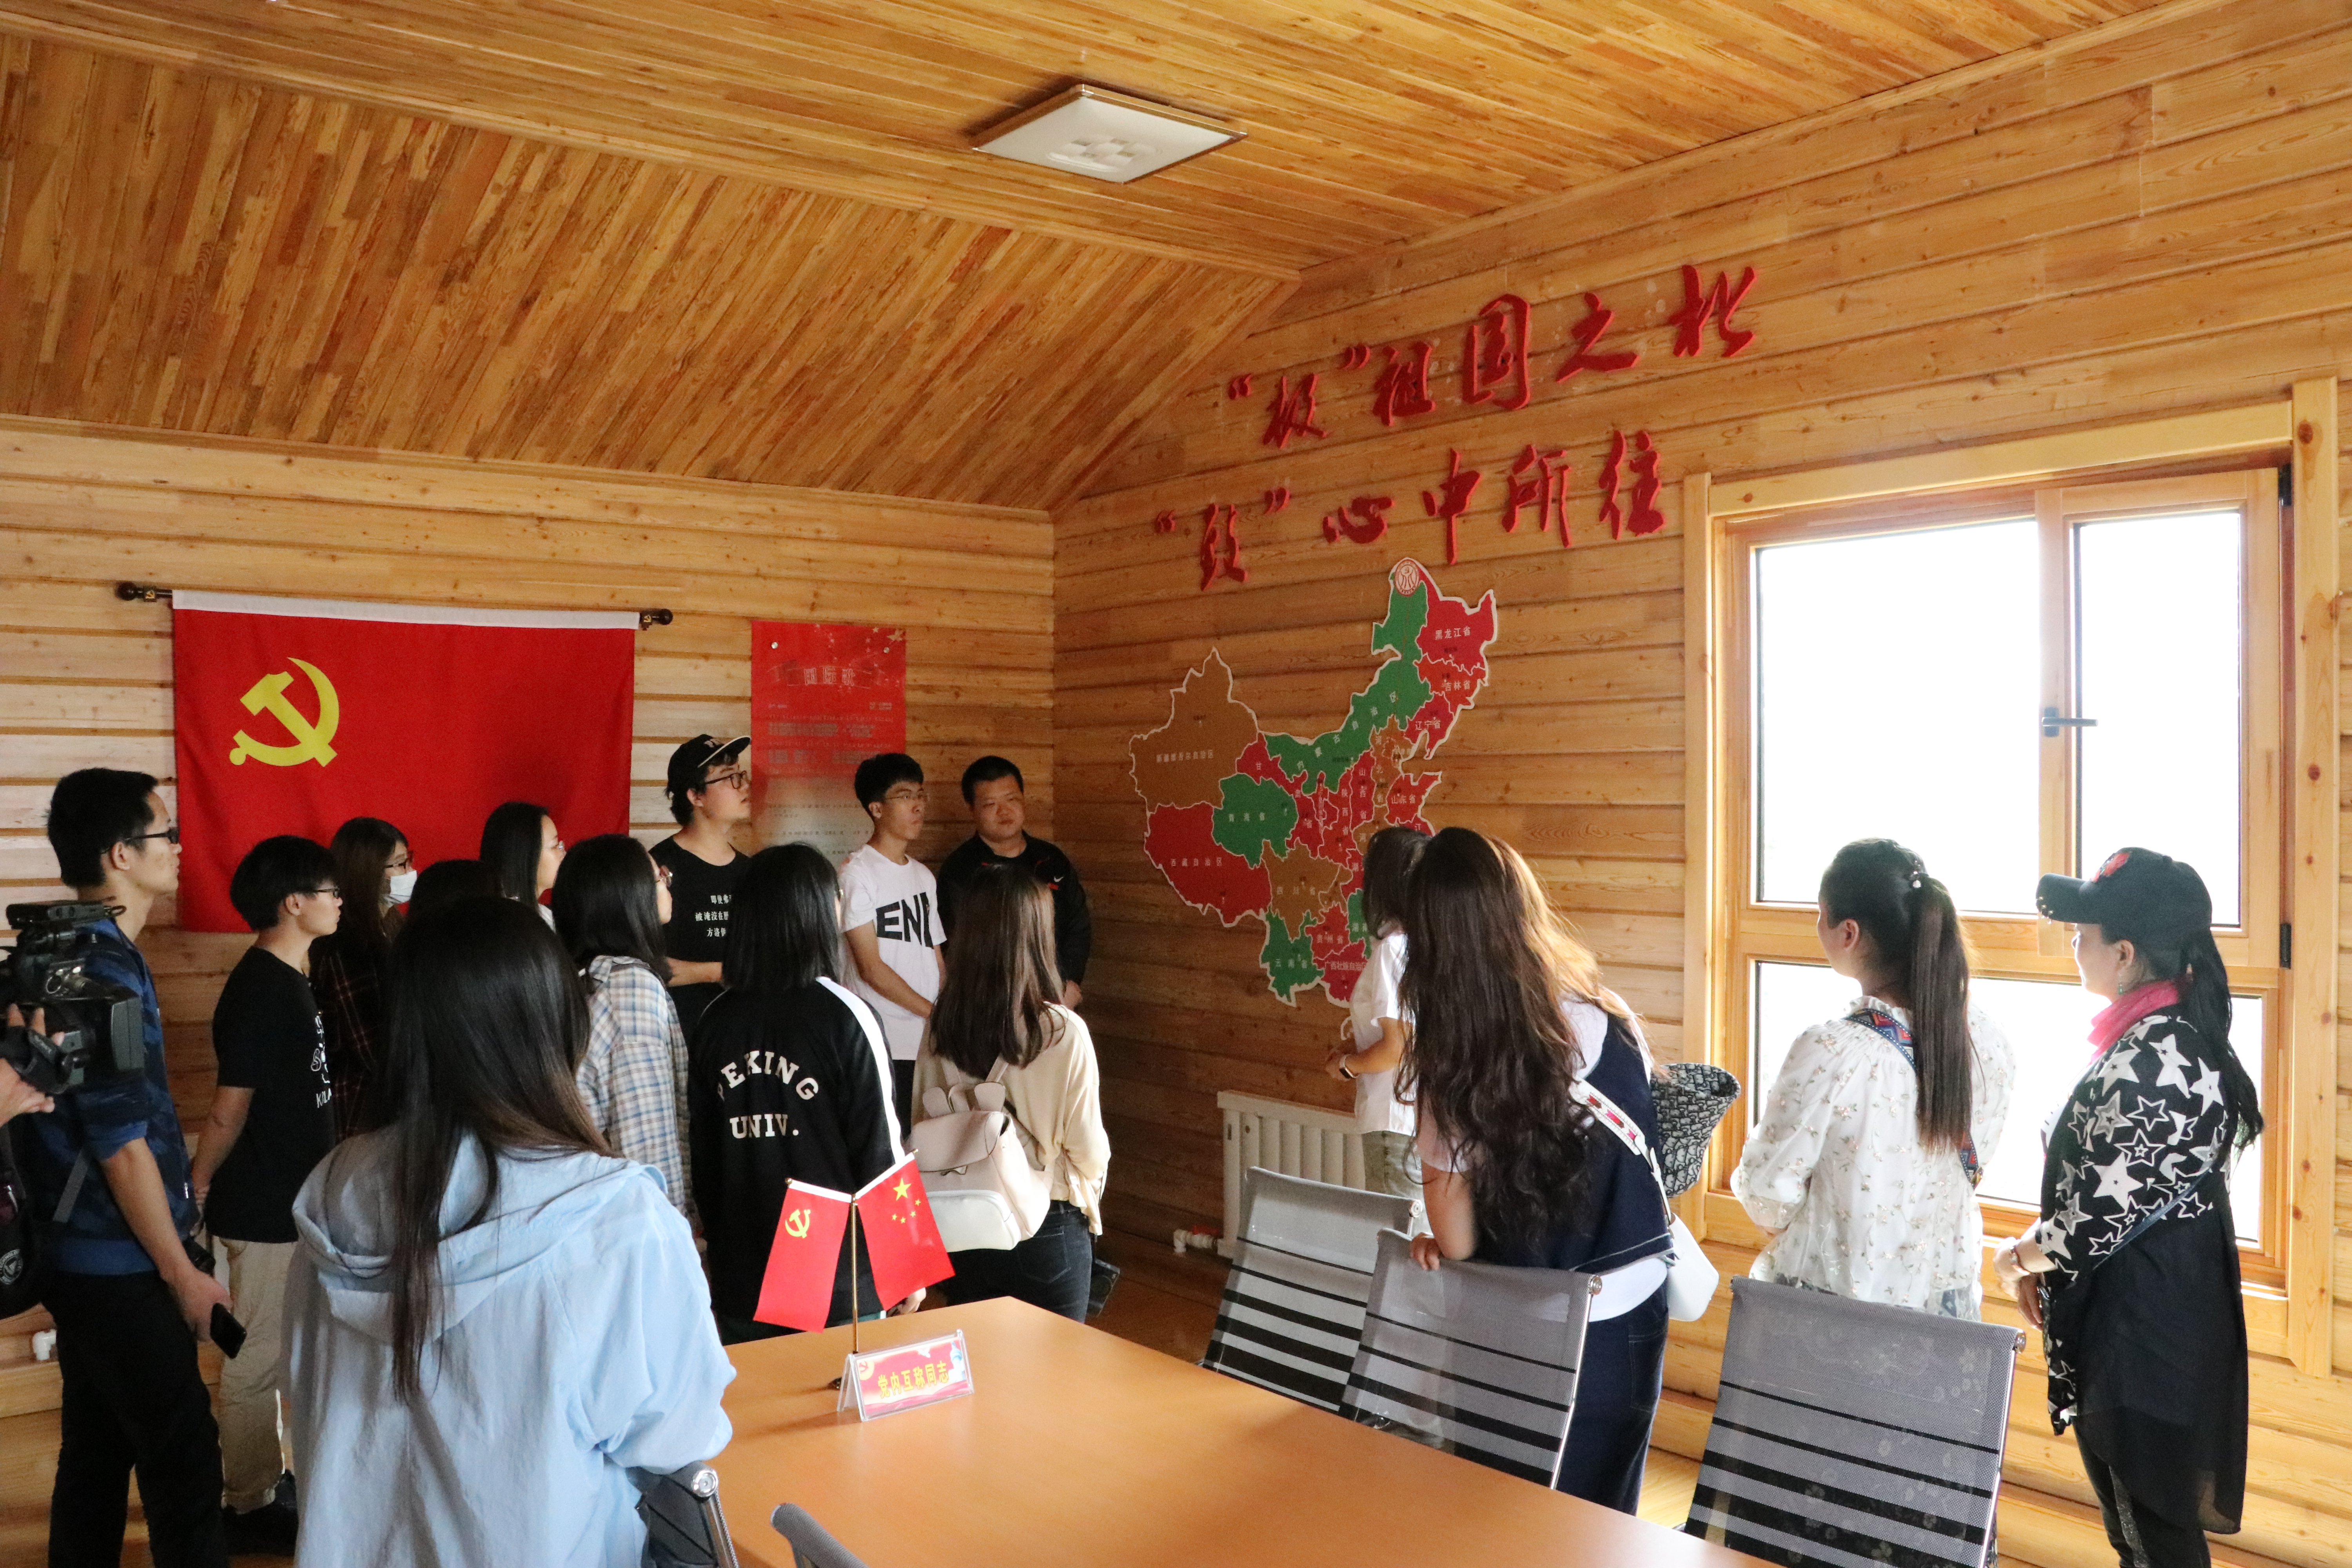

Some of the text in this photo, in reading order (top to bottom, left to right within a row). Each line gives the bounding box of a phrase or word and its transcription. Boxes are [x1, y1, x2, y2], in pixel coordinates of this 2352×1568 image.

[1435, 626, 1471, 641] 黑龙江省
[1444, 680, 1471, 691] 吉林省
[1415, 719, 1441, 730] 辽宁省
[1391, 794, 1416, 804] 山东省
[730, 1113, 799, 1139] UNIV.
[877, 1360, 949, 1399] 党内互称同志
